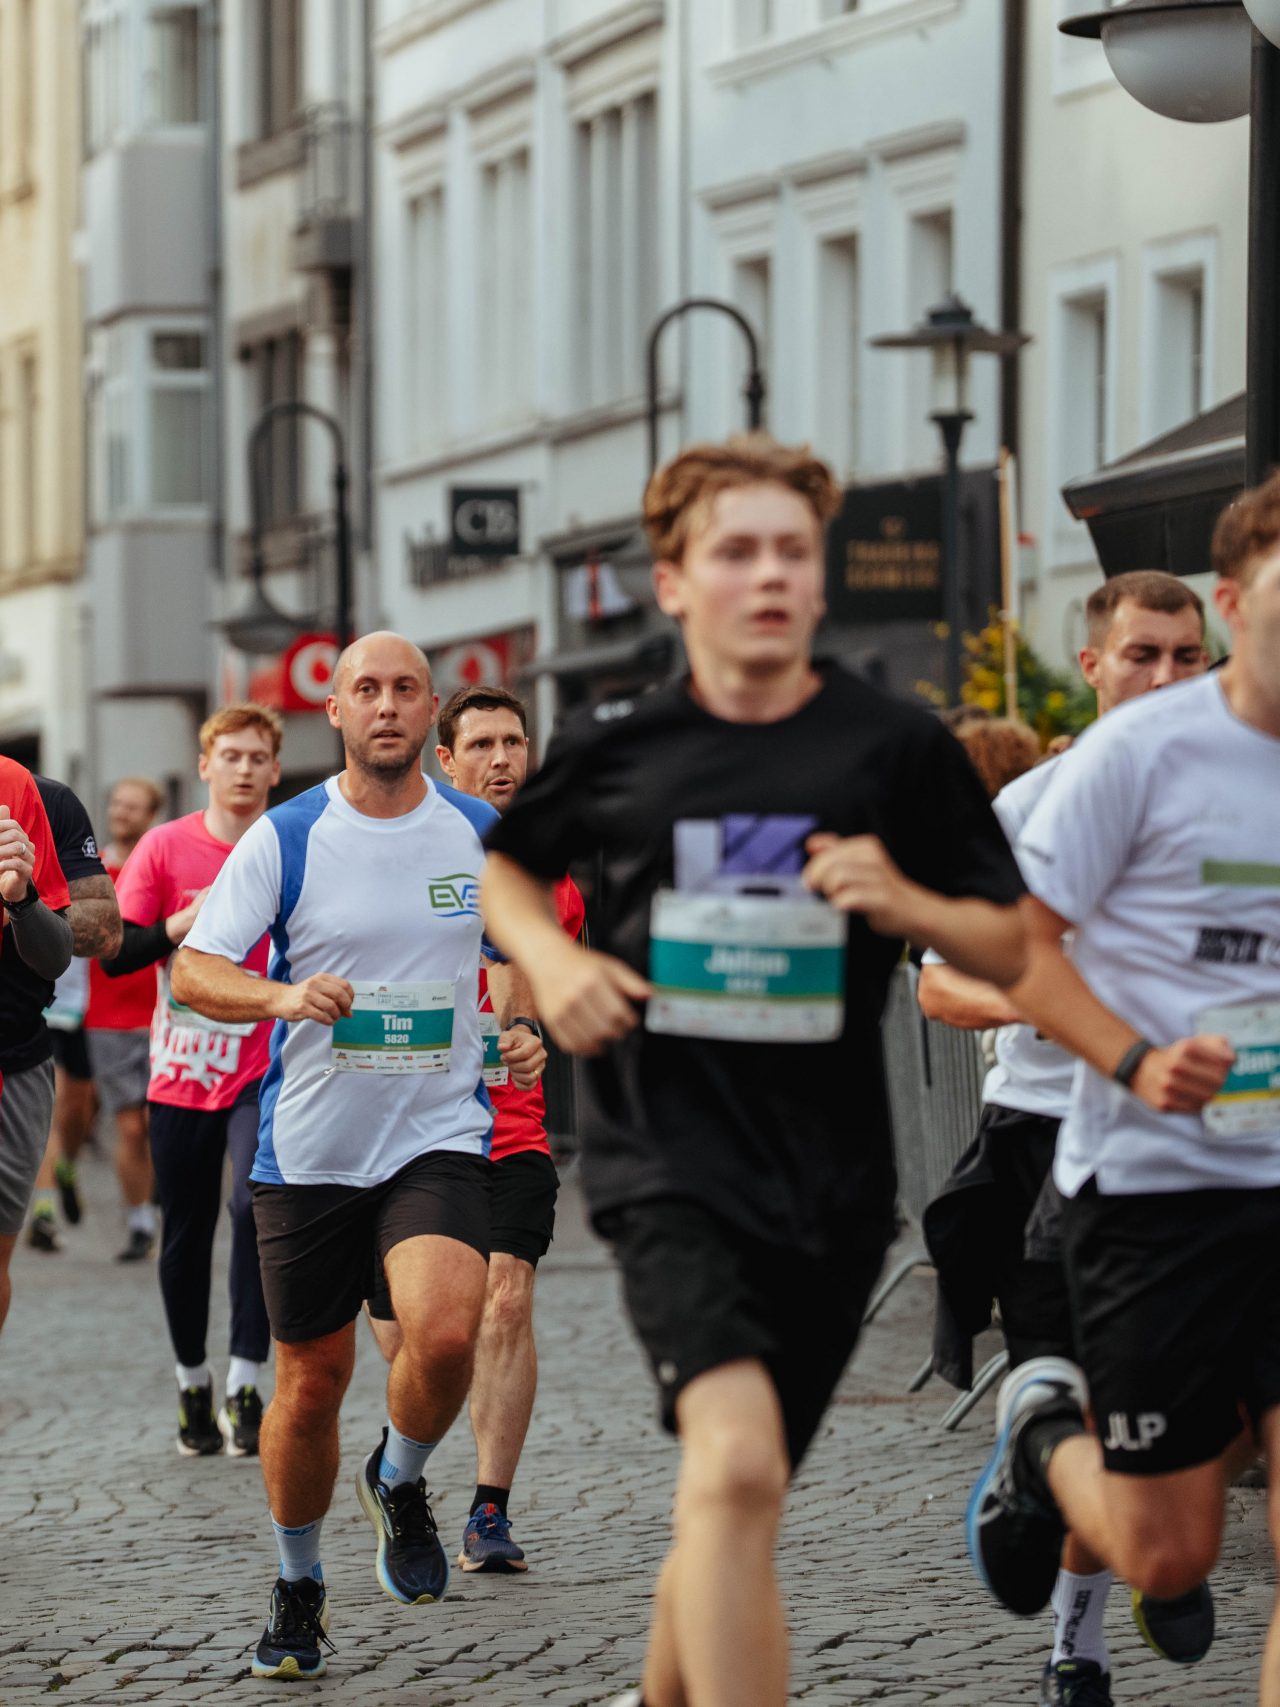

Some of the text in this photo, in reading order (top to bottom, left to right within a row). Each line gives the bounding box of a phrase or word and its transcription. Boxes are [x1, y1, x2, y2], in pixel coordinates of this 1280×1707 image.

[381, 1014, 414, 1031] Tim
[384, 1034, 410, 1044] 5820
[1104, 1411, 1168, 1452] JLP
